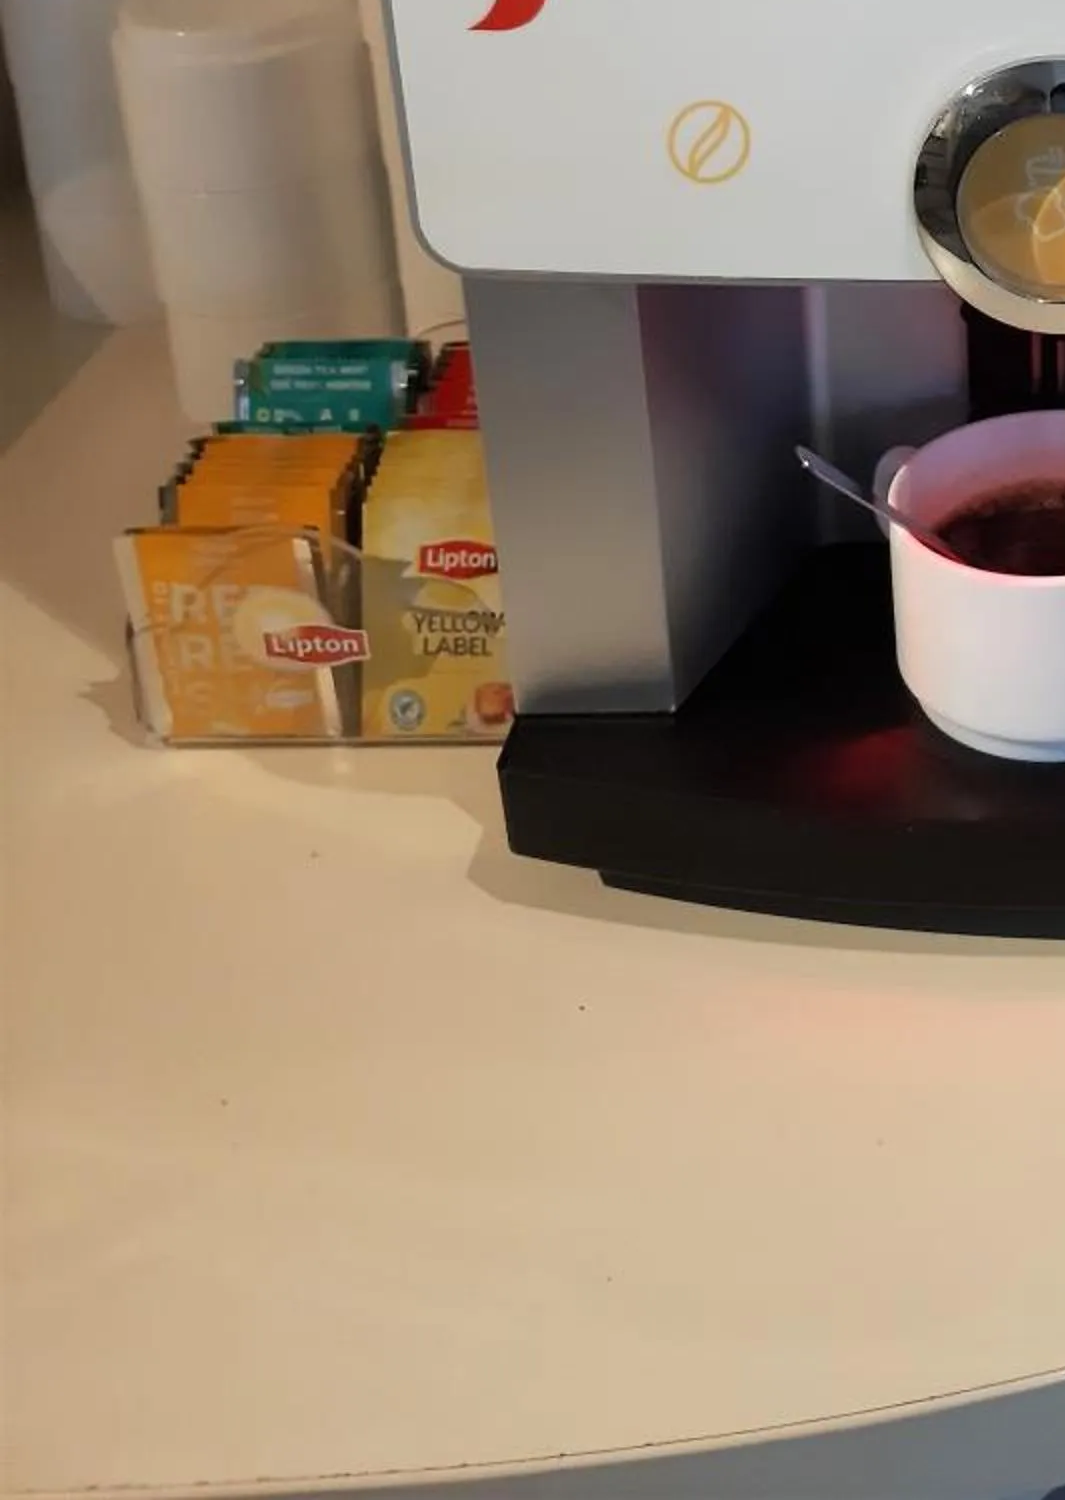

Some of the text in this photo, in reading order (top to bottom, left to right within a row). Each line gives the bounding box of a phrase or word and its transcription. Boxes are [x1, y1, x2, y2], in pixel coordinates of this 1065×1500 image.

[426, 547, 497, 571] Lipton
[413, 611, 505, 636] YELLOW
[270, 636, 358, 656] Lipton
[423, 637, 492, 657] LABEL
